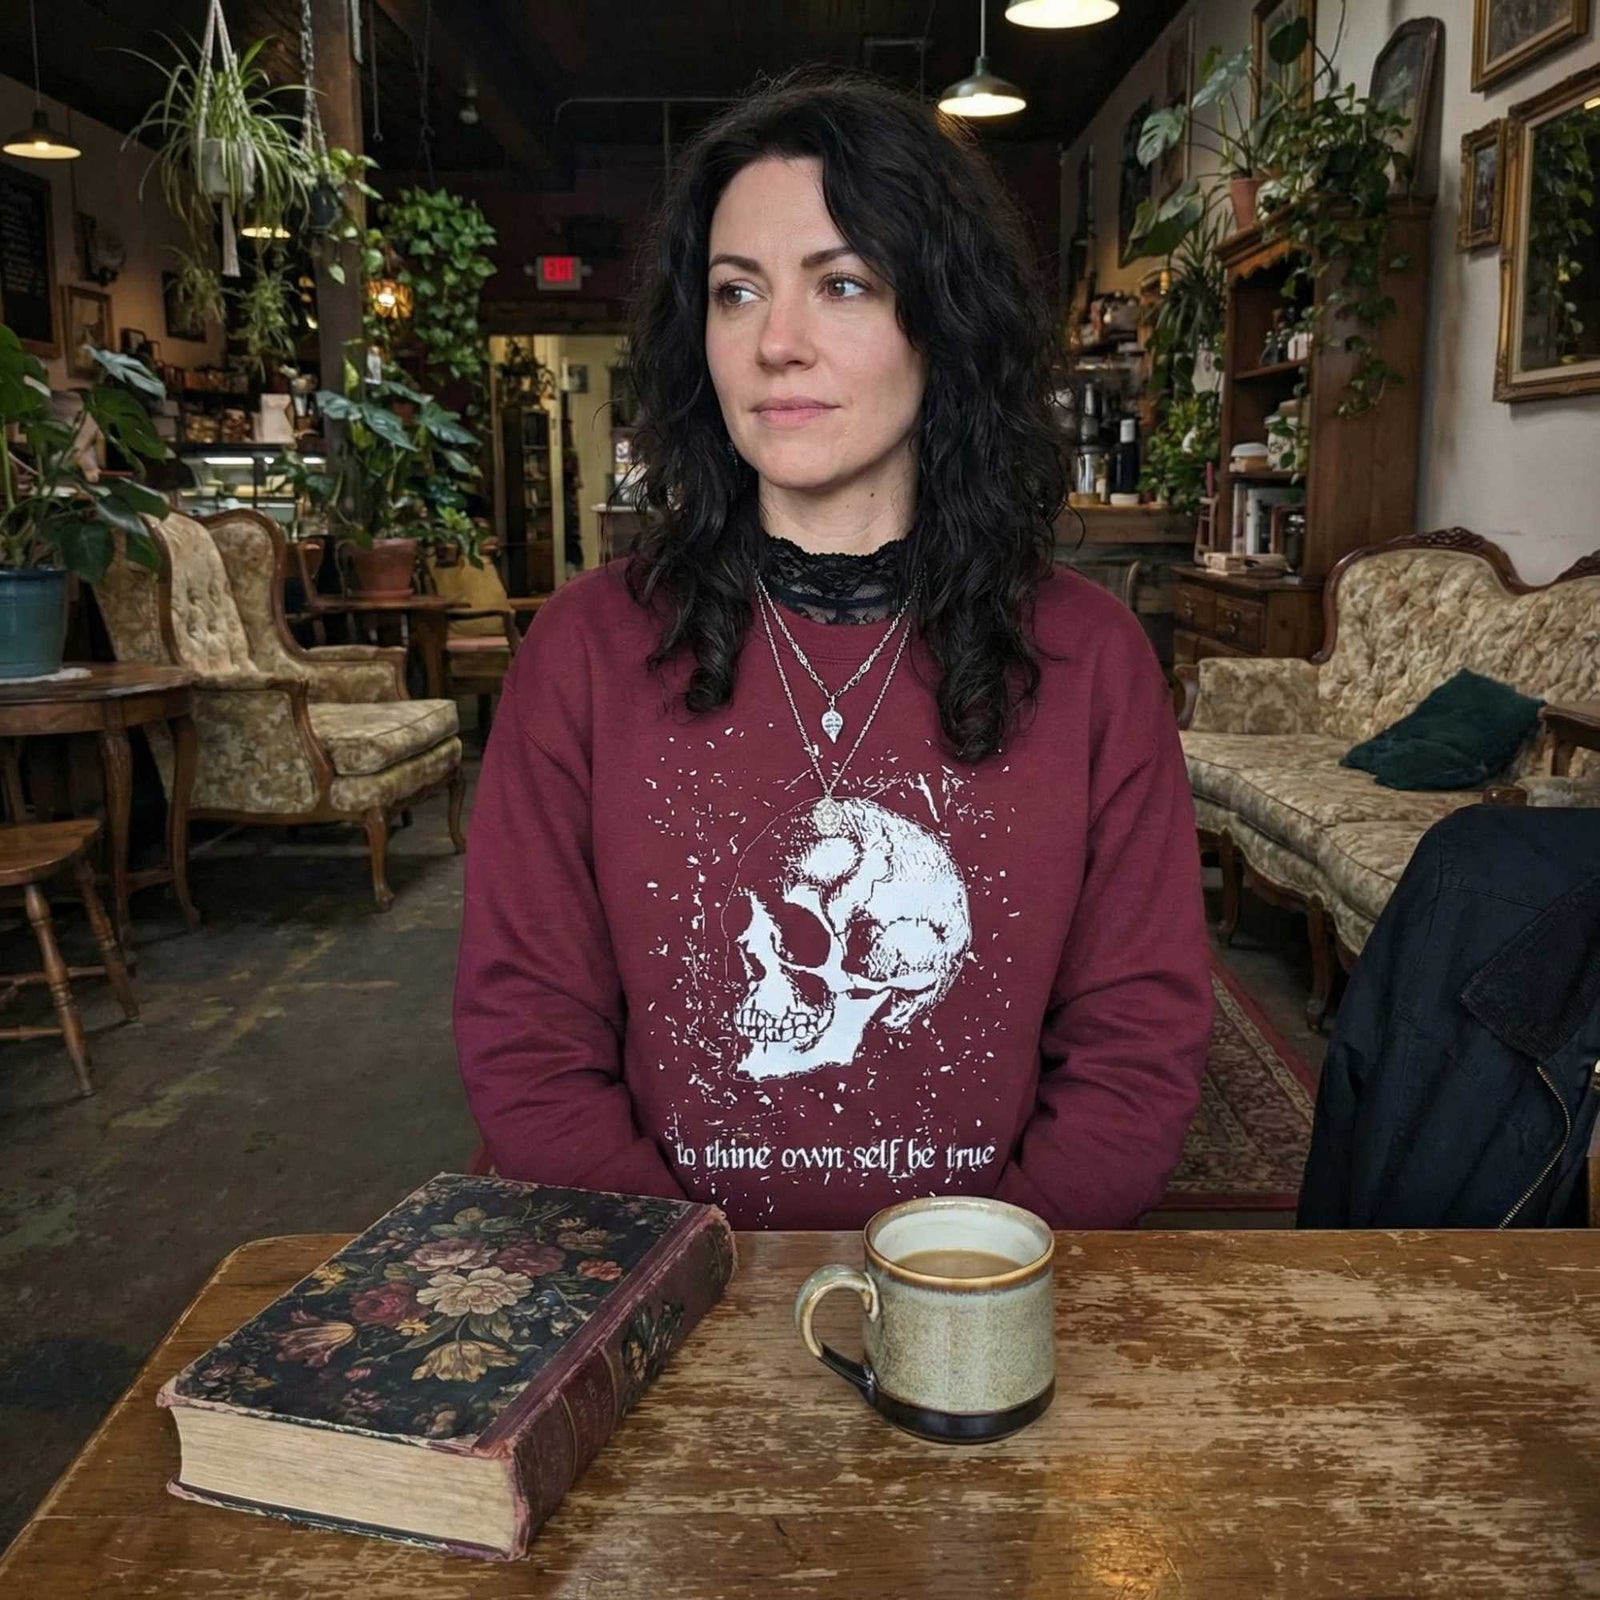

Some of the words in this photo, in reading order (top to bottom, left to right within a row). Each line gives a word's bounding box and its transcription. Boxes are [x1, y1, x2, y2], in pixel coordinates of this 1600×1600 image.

[704, 1138, 774, 1170] thine
[781, 1145, 845, 1169] own
[853, 1139, 904, 1175] self
[907, 1138, 936, 1169] be
[946, 1142, 996, 1170] true
